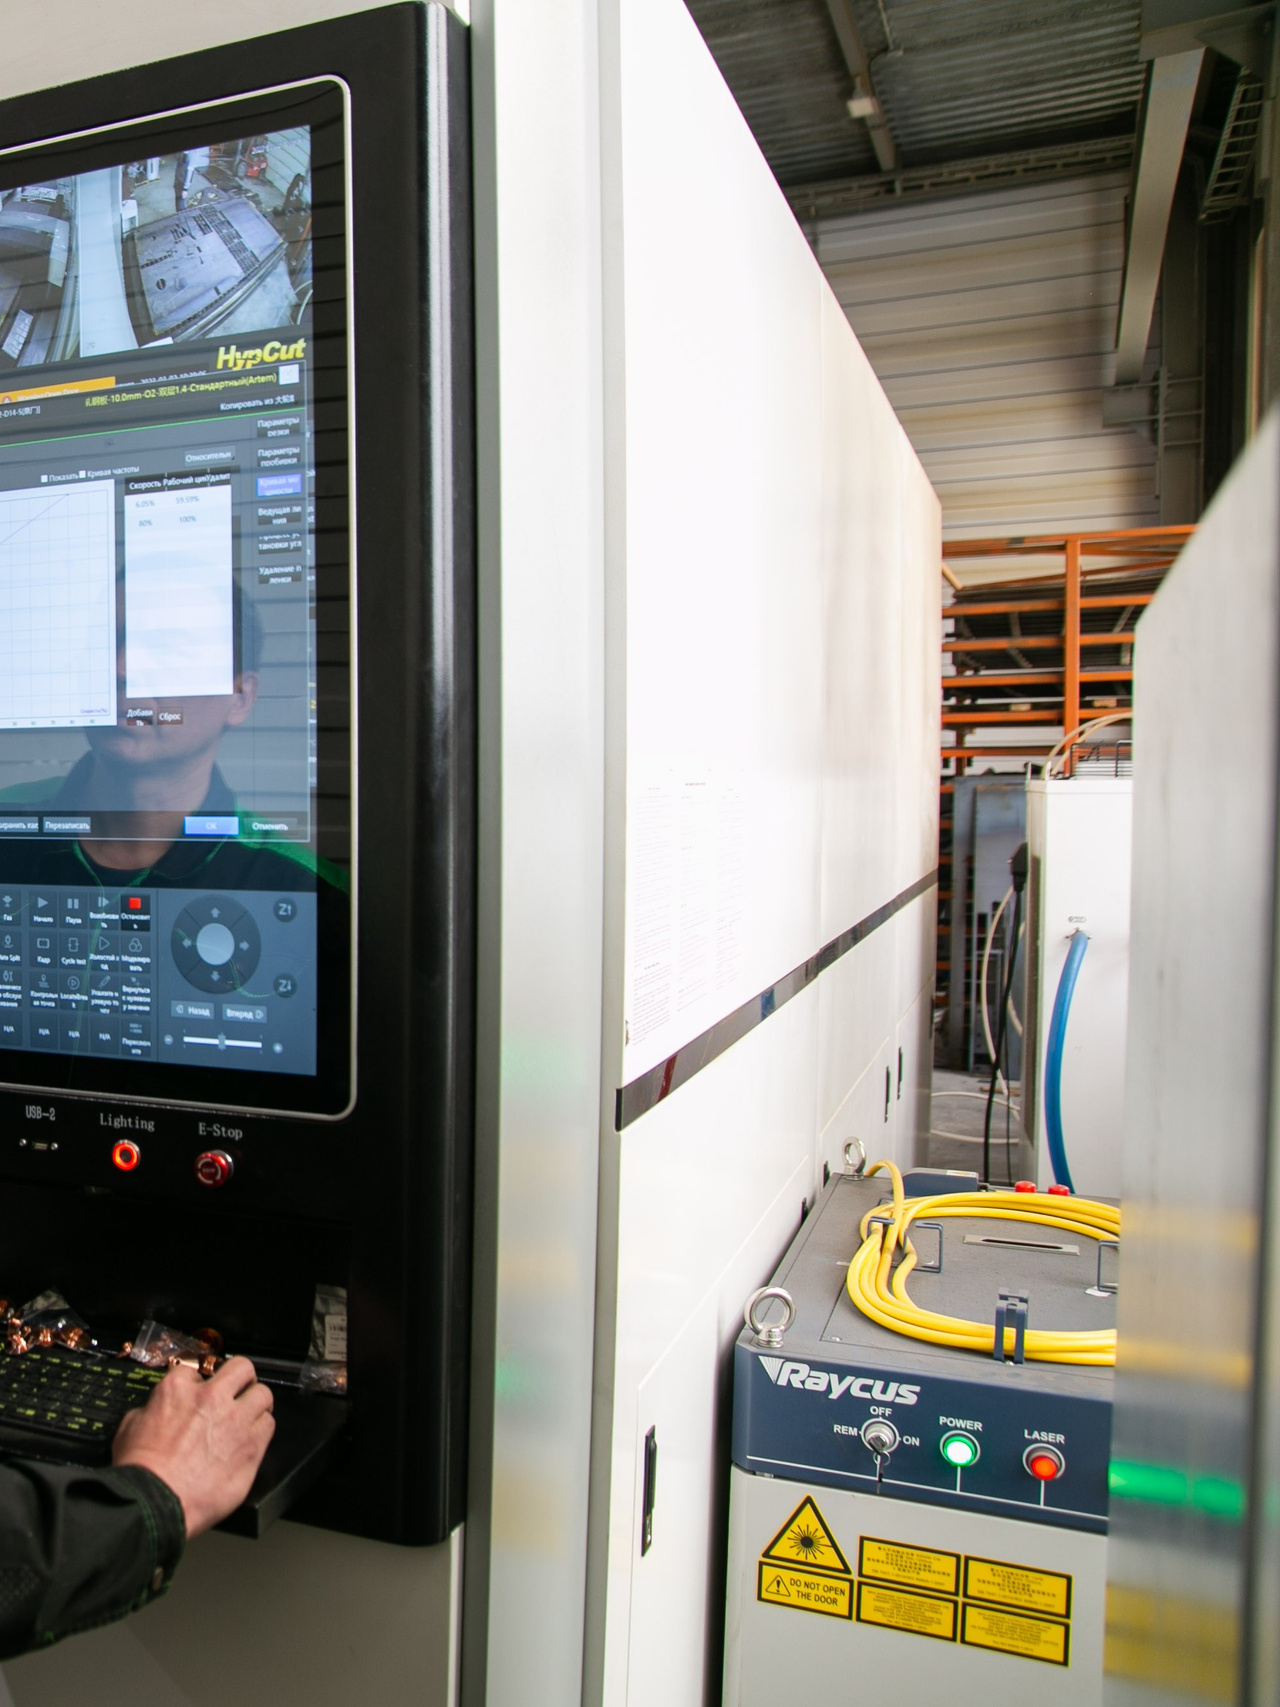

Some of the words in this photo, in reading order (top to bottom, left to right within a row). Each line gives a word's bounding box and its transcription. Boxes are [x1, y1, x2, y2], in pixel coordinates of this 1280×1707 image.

[217, 338, 307, 370] HypCut
[220, 400, 263, 411] Копировать
[258, 416, 299, 428] Параметры
[185, 452, 232, 463] Относительн
[258, 447, 300, 458] Параметры
[260, 457, 297, 467] пробивки
[49, 472, 79, 482] Показать
[87, 470, 109, 480] Кривая
[112, 466, 140, 476] частоты
[206, 472, 231, 483] Удалит
[129, 480, 161, 490] Скорость
[163, 477, 193, 487] Рабочий
[136, 500, 155, 508] 6.05%
[176, 495, 200, 504] 59.59%
[258, 507, 290, 517] Ведущая
[179, 515, 197, 524] 100%
[258, 541, 289, 550] тановки
[289, 540, 302, 549] угл
[259, 566, 294, 576] Удаление
[269, 576, 292, 584] ленки
[127, 709, 153, 718] Добави
[159, 712, 181, 722] Сброс
[45, 821, 90, 831] Перезаписать
[252, 822, 288, 832] Отменить
[65, 916, 82, 925] Пауза
[61, 957, 76, 966] Cycle
[188, 1006, 211, 1018] Назад
[226, 1008, 254, 1020] Вперед
[3, 1025, 15, 1033] N/A
[38, 1028, 51, 1036] N/A
[68, 1030, 80, 1038] N/A
[99, 1033, 111, 1041] N/A
[25, 1105, 56, 1121] USB-2
[99, 1113, 155, 1132] Lighting
[198, 1122, 243, 1141] E-Stop
[778, 1362, 921, 1405] Raycus
[870, 1405, 893, 1418] OFF
[939, 1416, 983, 1431] POWER
[833, 1424, 858, 1436] REM
[902, 1435, 920, 1447] ON
[1024, 1429, 1066, 1444] LASER
[789, 1578, 802, 1588] DO
[804, 1580, 821, 1591] NOT
[822, 1583, 846, 1597] OPEN
[796, 1589, 812, 1600] THE
[814, 1593, 839, 1606] DOOR
